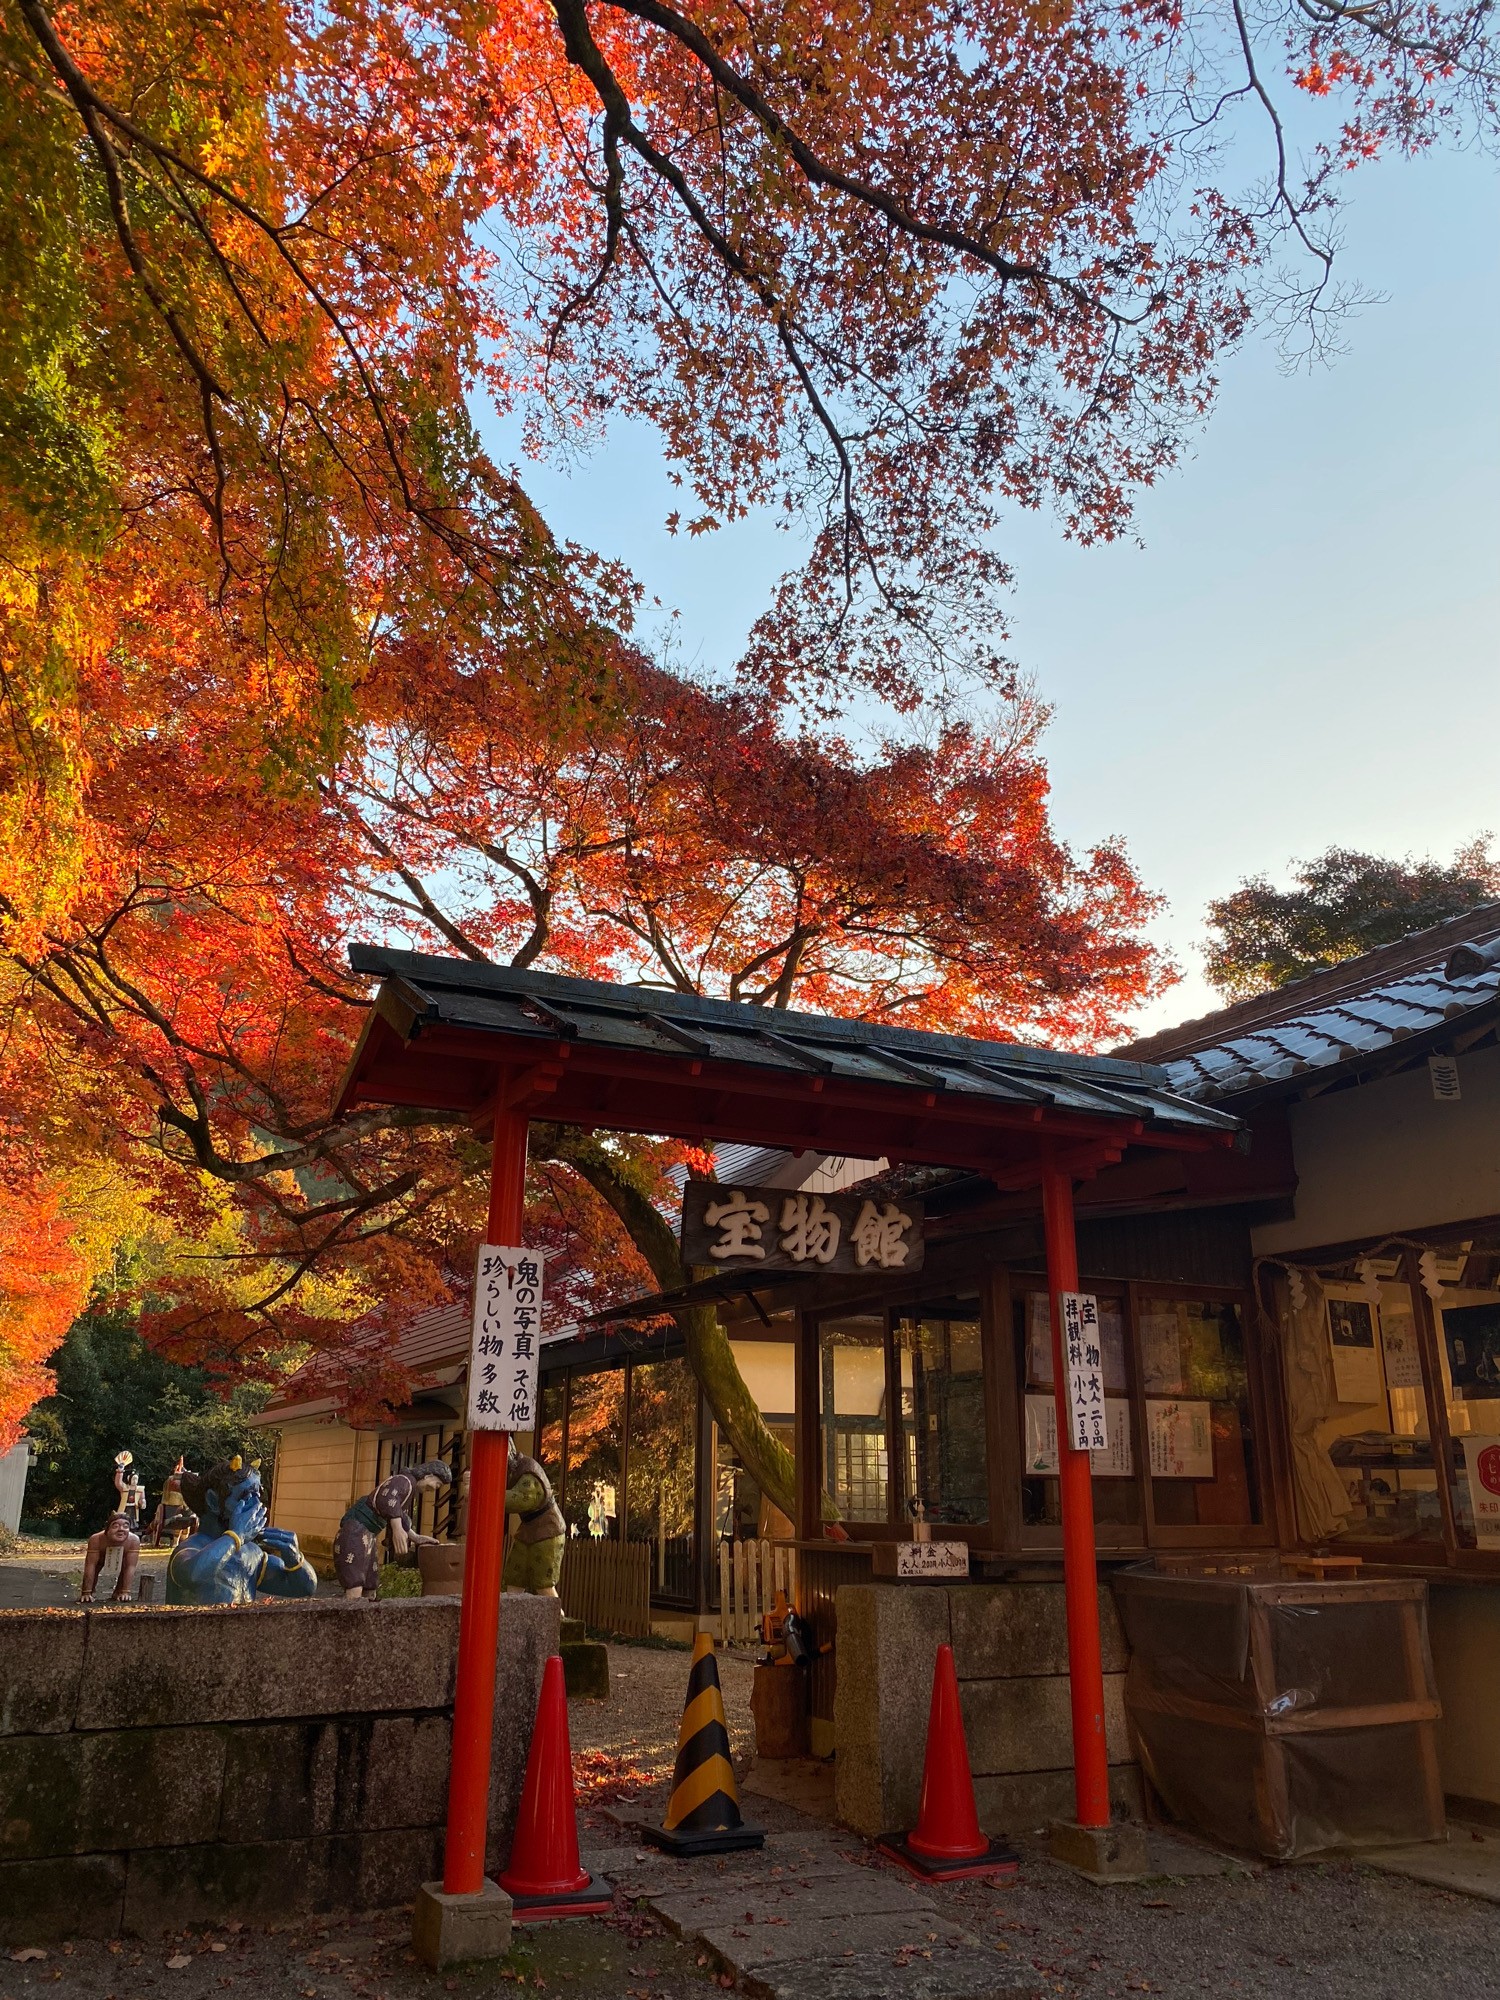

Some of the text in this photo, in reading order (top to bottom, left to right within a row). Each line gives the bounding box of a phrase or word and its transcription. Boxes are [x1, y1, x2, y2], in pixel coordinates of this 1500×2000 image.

[703, 1190, 912, 1268] 宝物館
[476, 1255, 507, 1414] 珍らしい物多数
[1066, 1298, 1082, 1367] 拝観料
